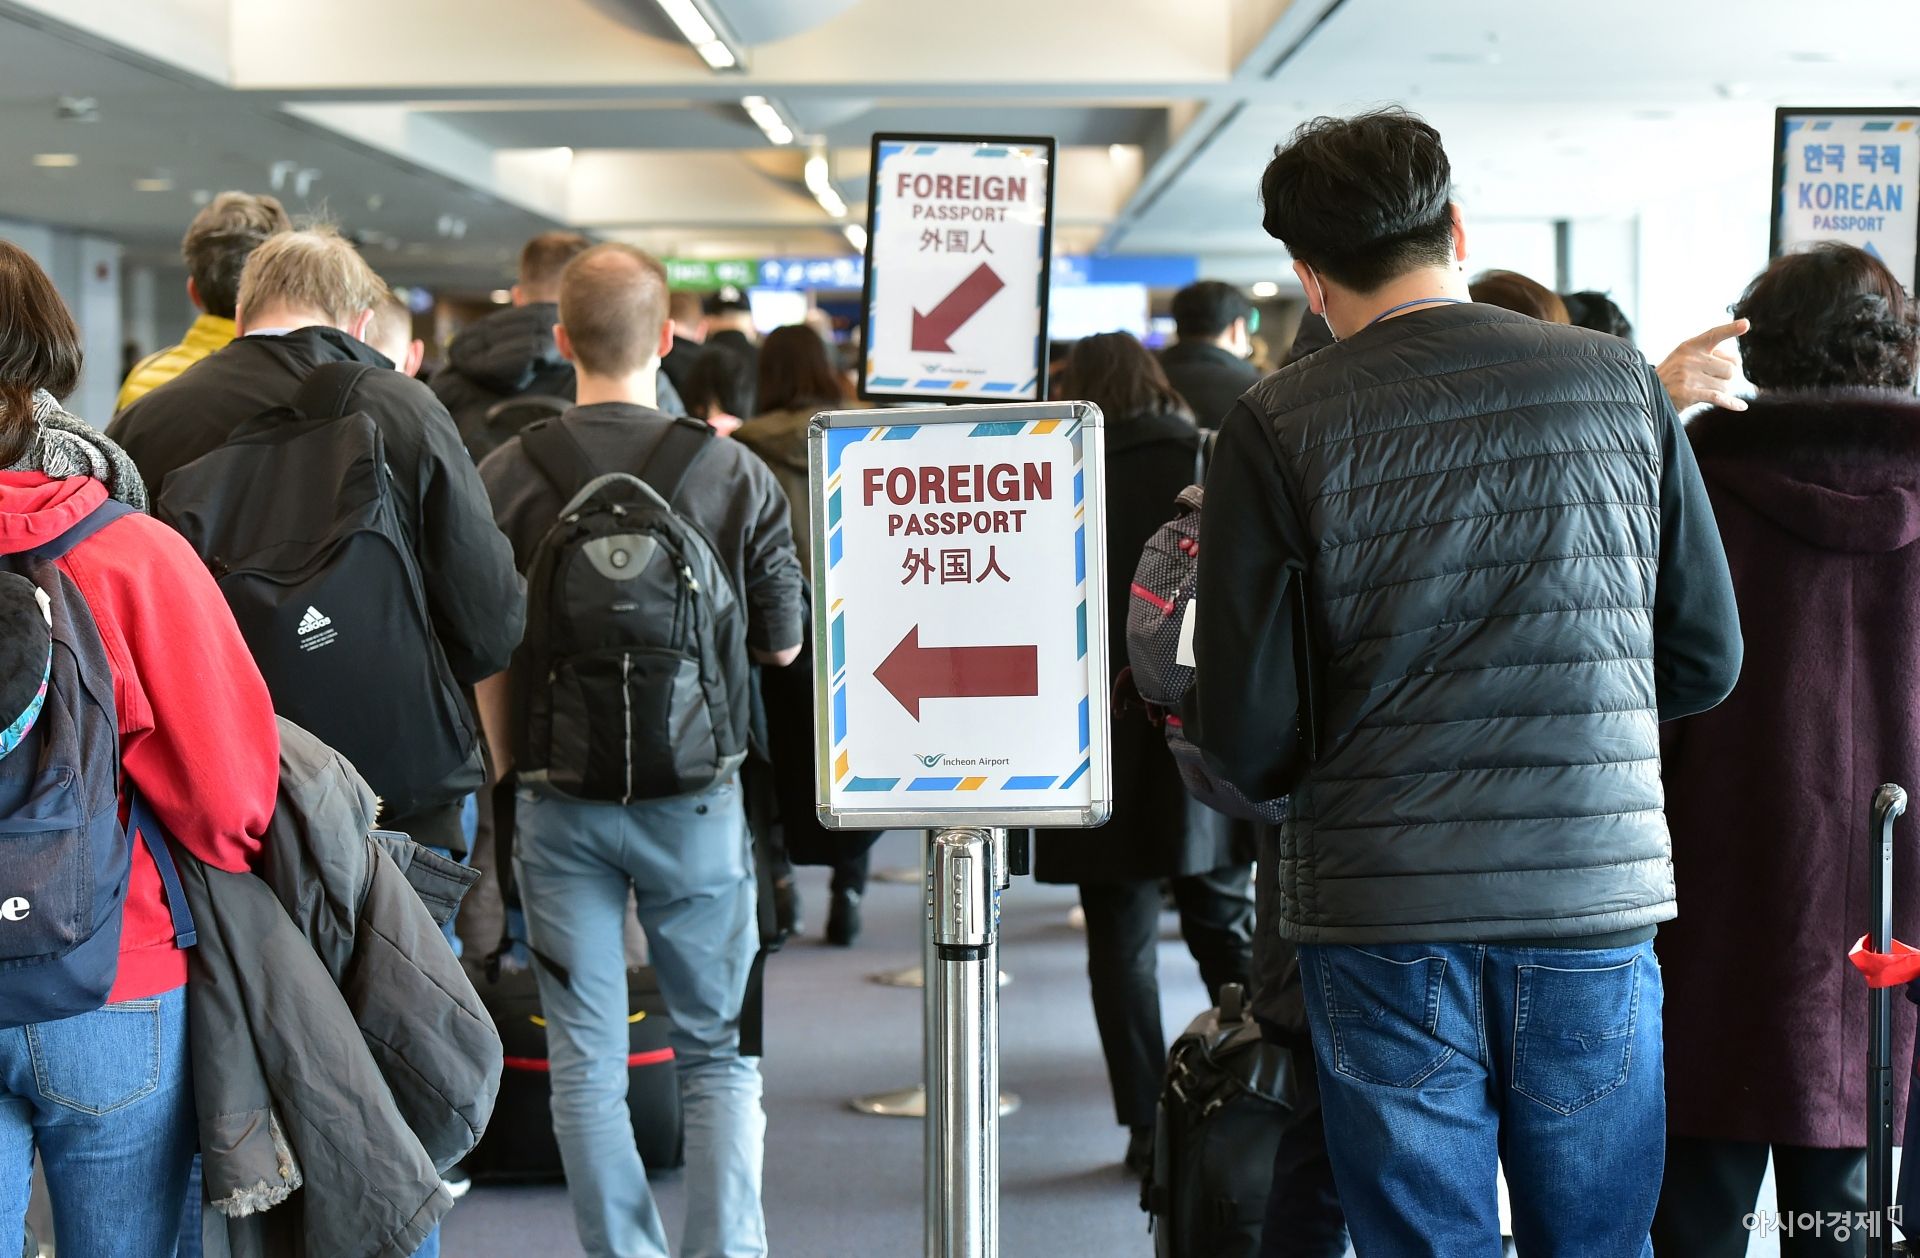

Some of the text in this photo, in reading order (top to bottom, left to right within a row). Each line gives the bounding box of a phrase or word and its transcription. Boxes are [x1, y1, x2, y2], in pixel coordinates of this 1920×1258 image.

[1803, 144, 1901, 174] 한국 국적
[897, 173, 1027, 201] FOREIGN
[1798, 182, 1903, 211] KOREAN
[912, 204, 1008, 222] PASSPORT
[1812, 215, 1885, 231] PASSPORT
[919, 228, 994, 254] 外国人
[862, 461, 1053, 507] FOREIGN
[888, 509, 1027, 537] PASSPORT
[900, 545, 1011, 585] 外国人
[297, 616, 332, 635] adidas
[943, 757, 1010, 767] Incheon Airport
